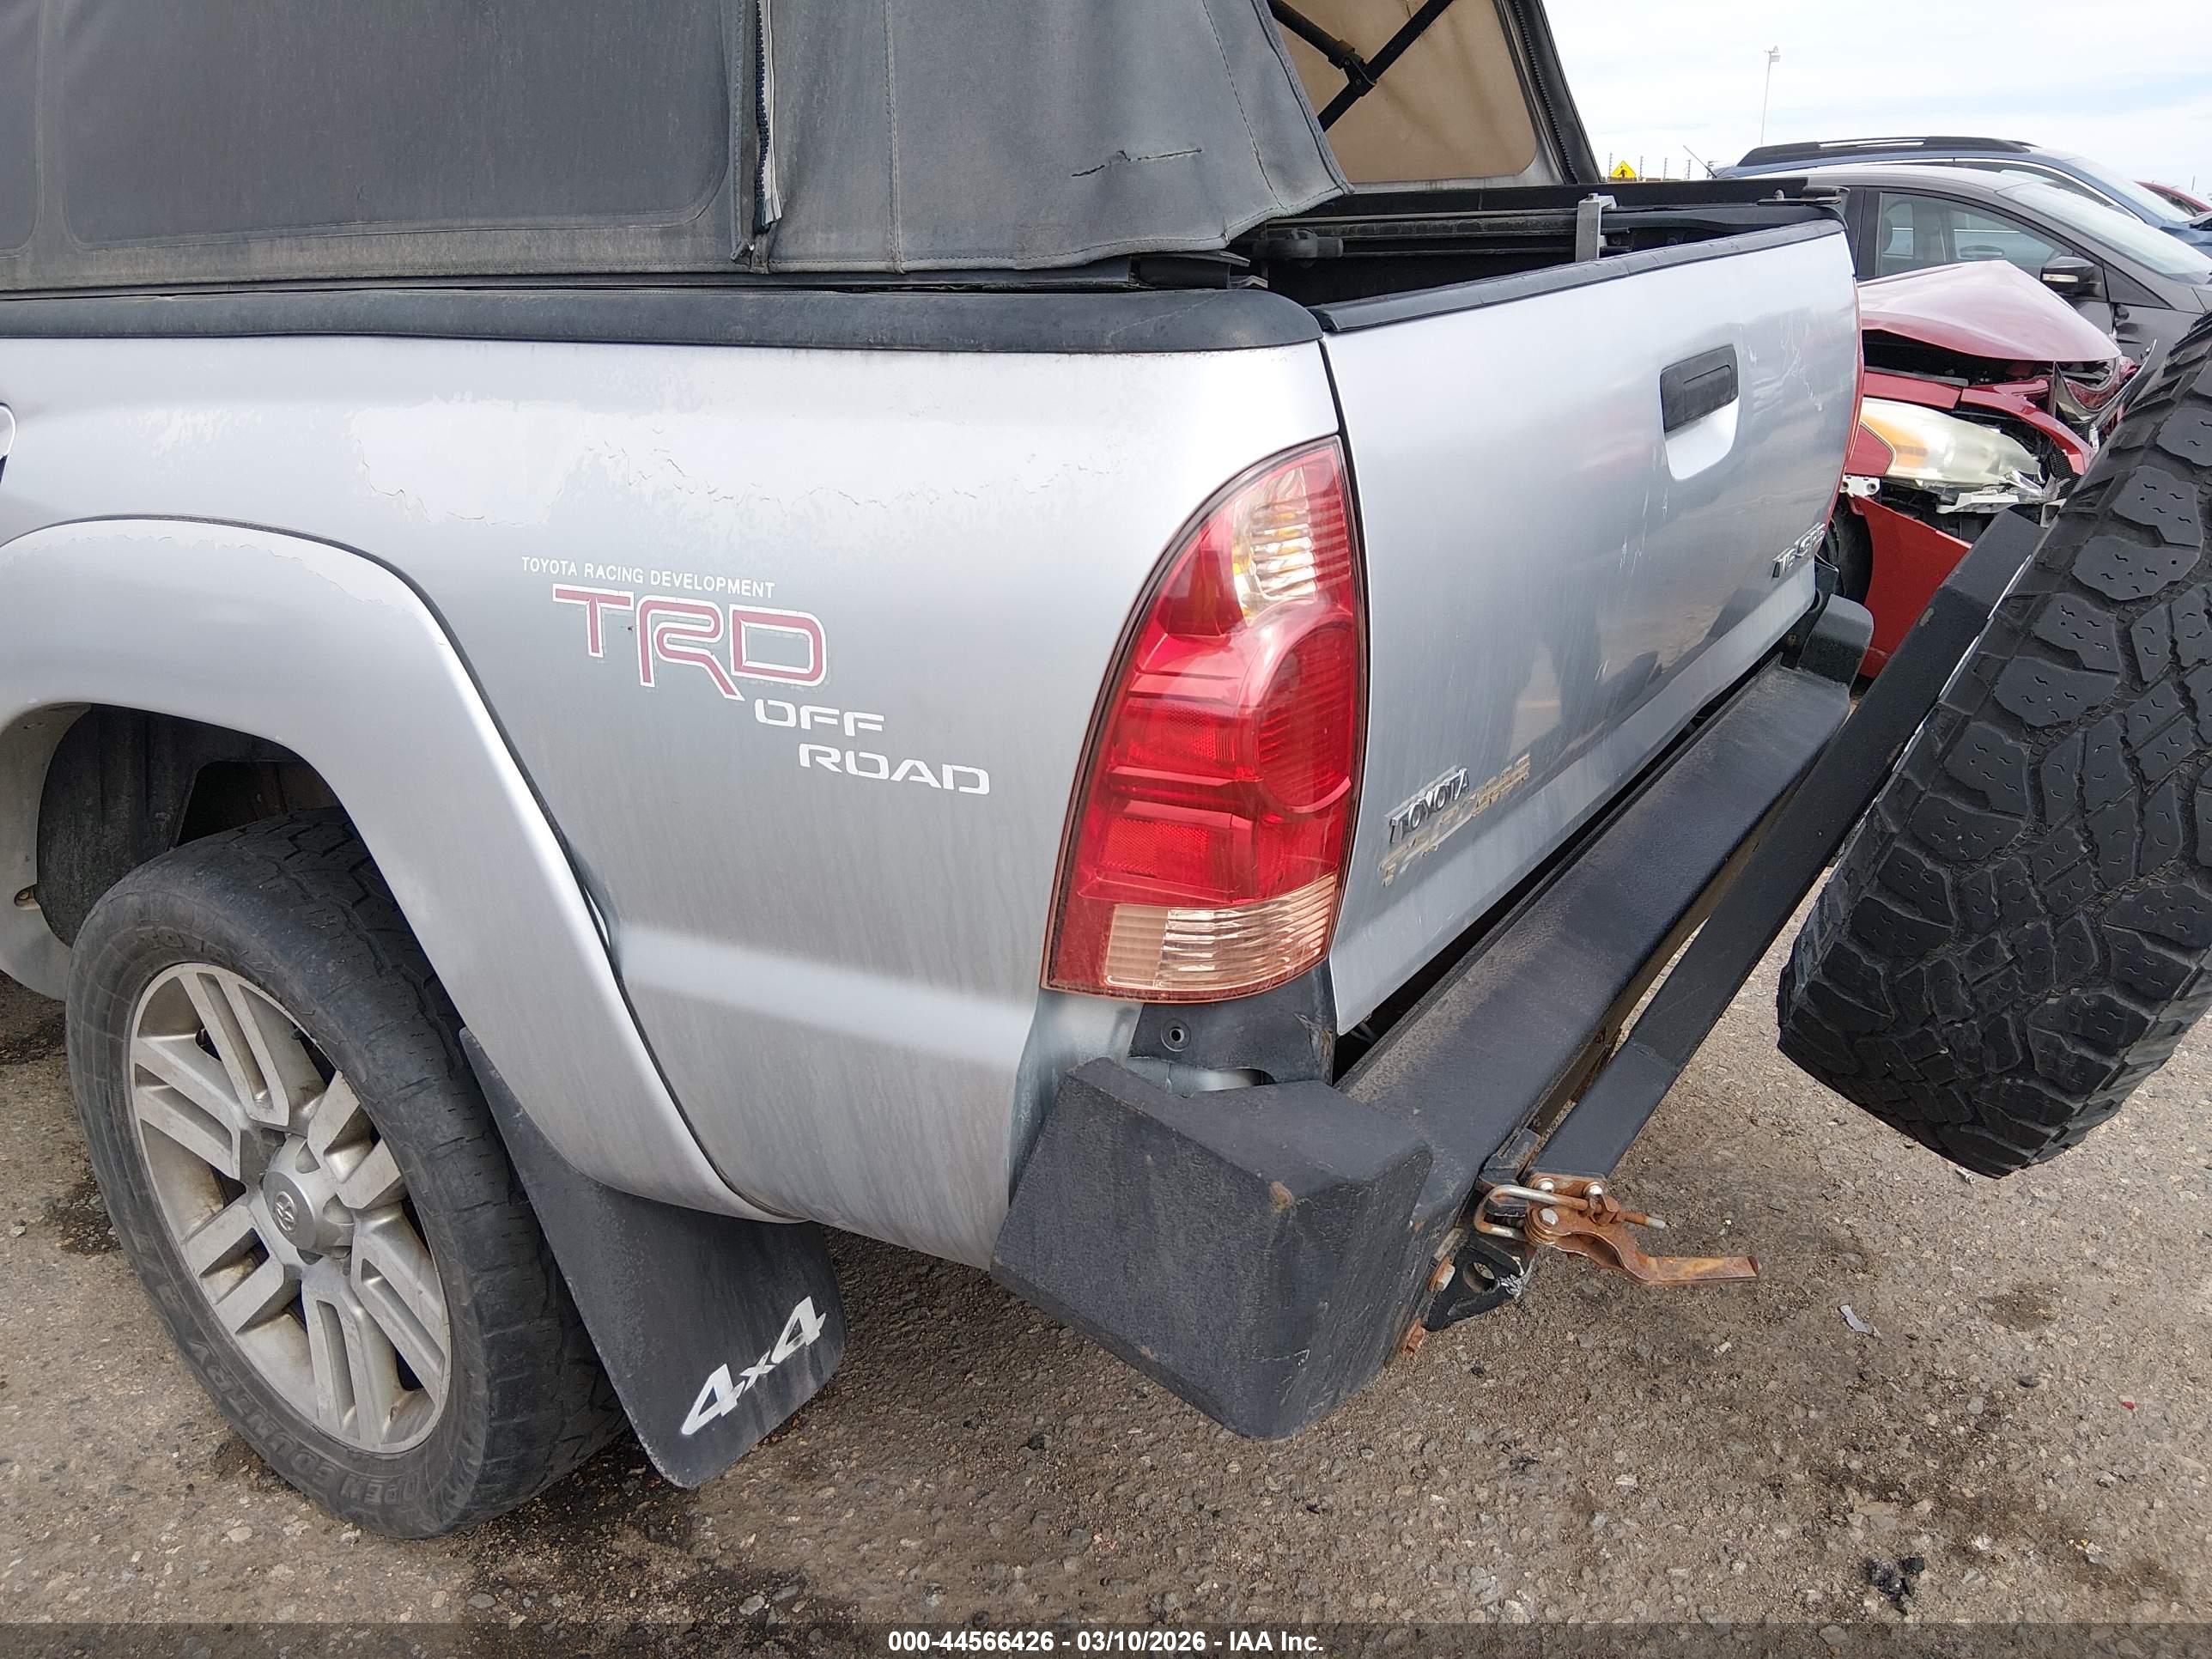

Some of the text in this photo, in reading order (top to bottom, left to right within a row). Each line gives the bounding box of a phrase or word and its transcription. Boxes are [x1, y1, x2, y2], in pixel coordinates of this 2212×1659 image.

[522, 556, 775, 599] TOYOTA RACING DEVELOPMENT
[552, 583, 828, 701] TRD
[754, 698, 884, 737] OFF
[799, 743, 990, 795] ROAD
[1389, 767, 1469, 843] TOYOTA
[681, 1295, 827, 1435] 4x4
